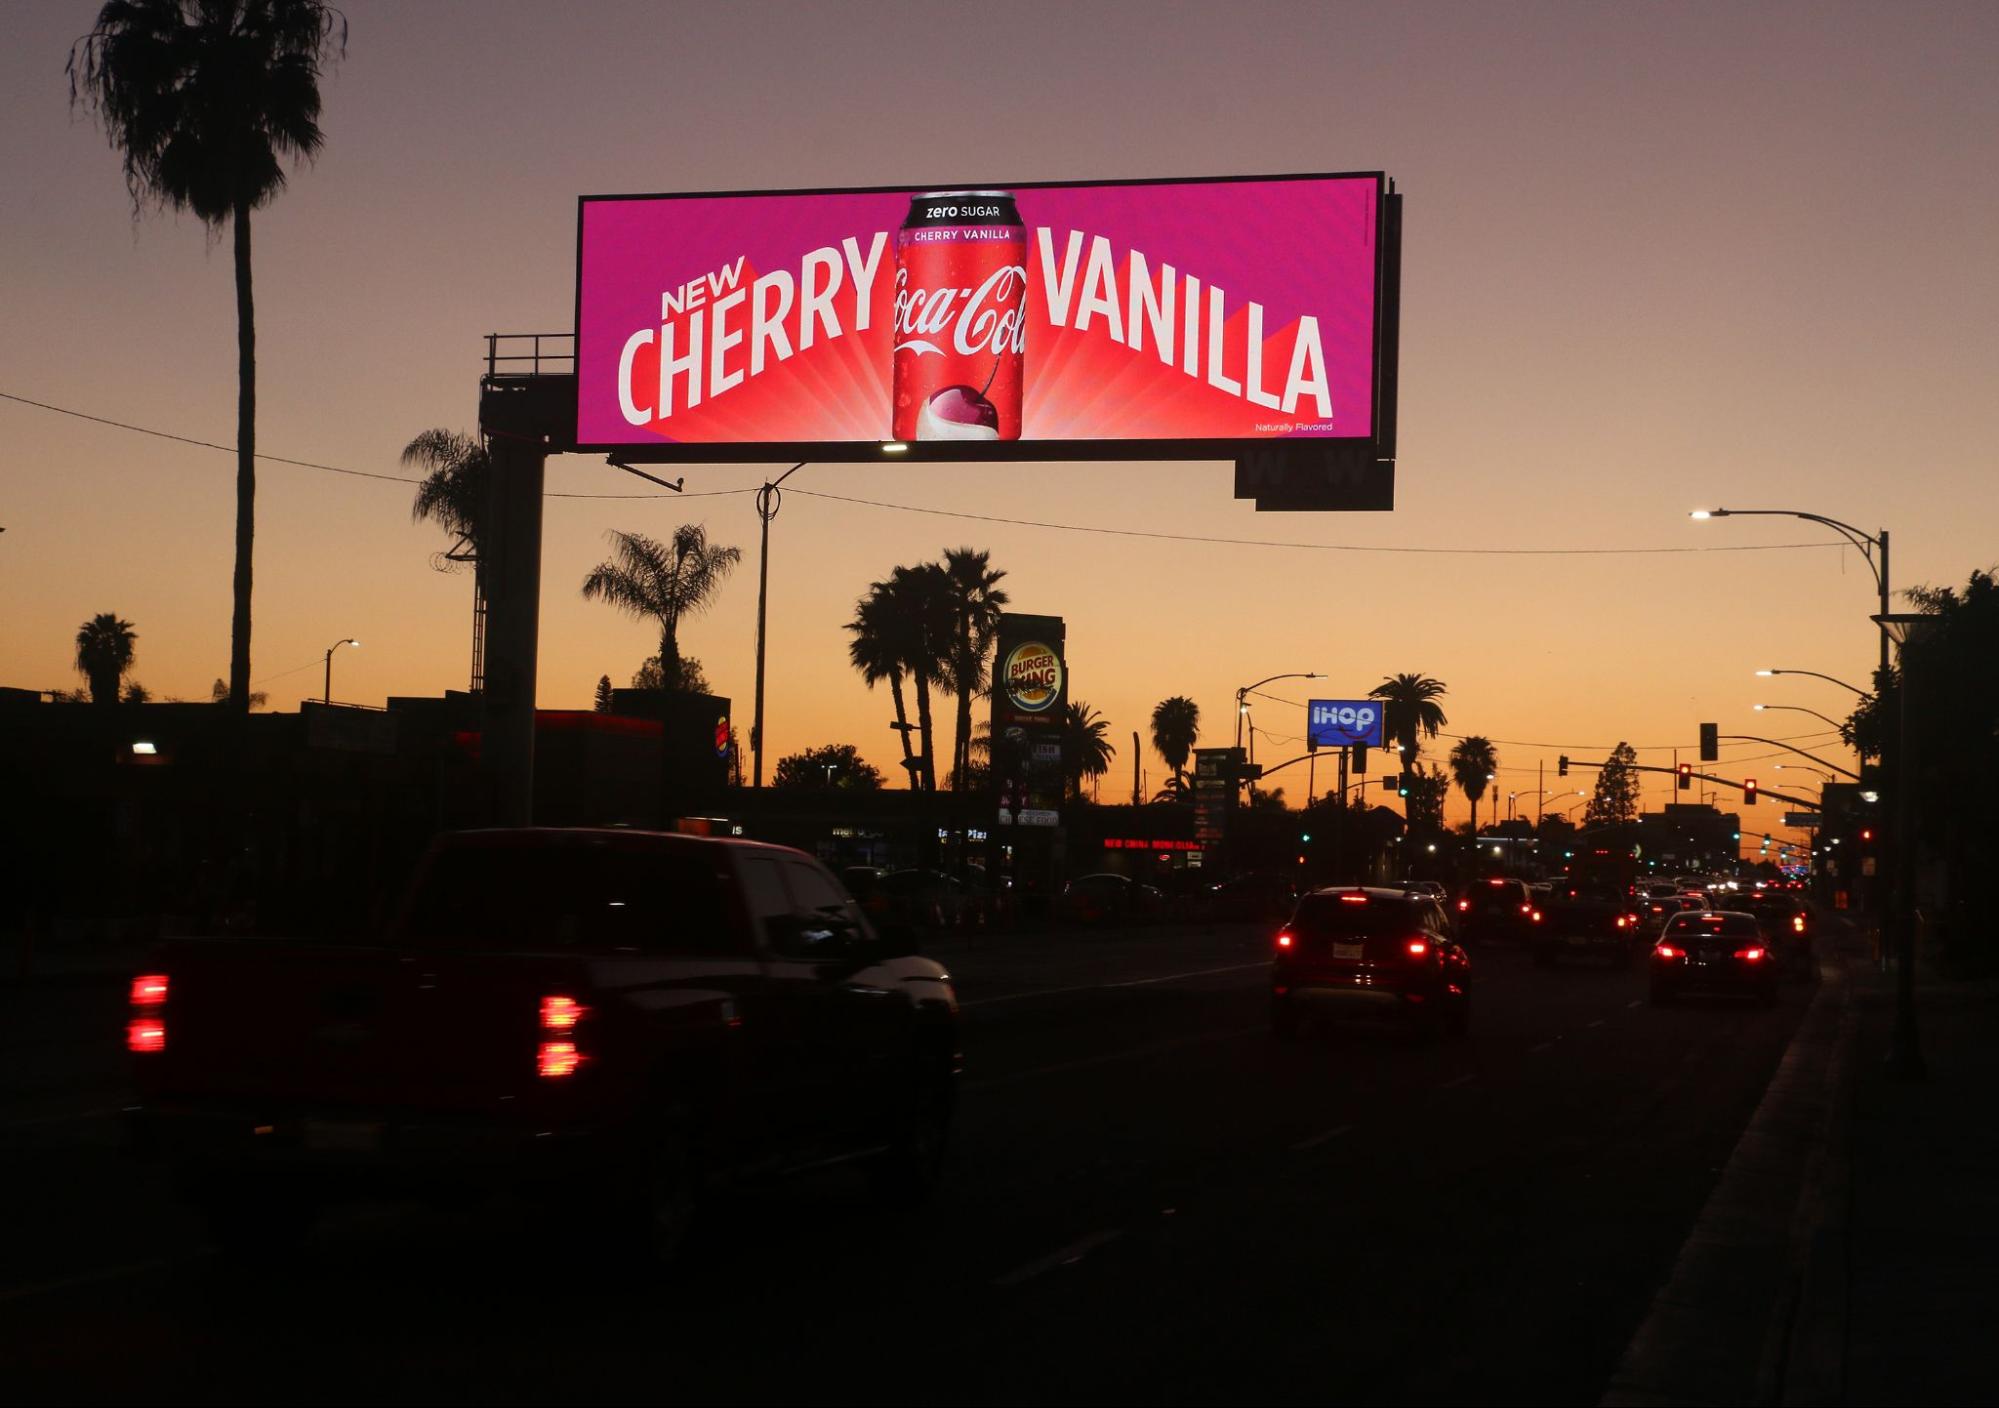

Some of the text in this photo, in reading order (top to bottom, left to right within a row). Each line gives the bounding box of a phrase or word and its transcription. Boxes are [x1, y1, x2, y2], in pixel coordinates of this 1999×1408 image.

[926, 206, 1000, 218] zero SUGAR
[914, 229, 1010, 242] CHERRY VANILLA
[661, 255, 746, 320] NEW
[618, 226, 1333, 426] CHERRY VANILLA
[1255, 422, 1333, 433] Naturally Flavored
[1011, 655, 1054, 677] BURGER
[1012, 667, 1056, 685] ING
